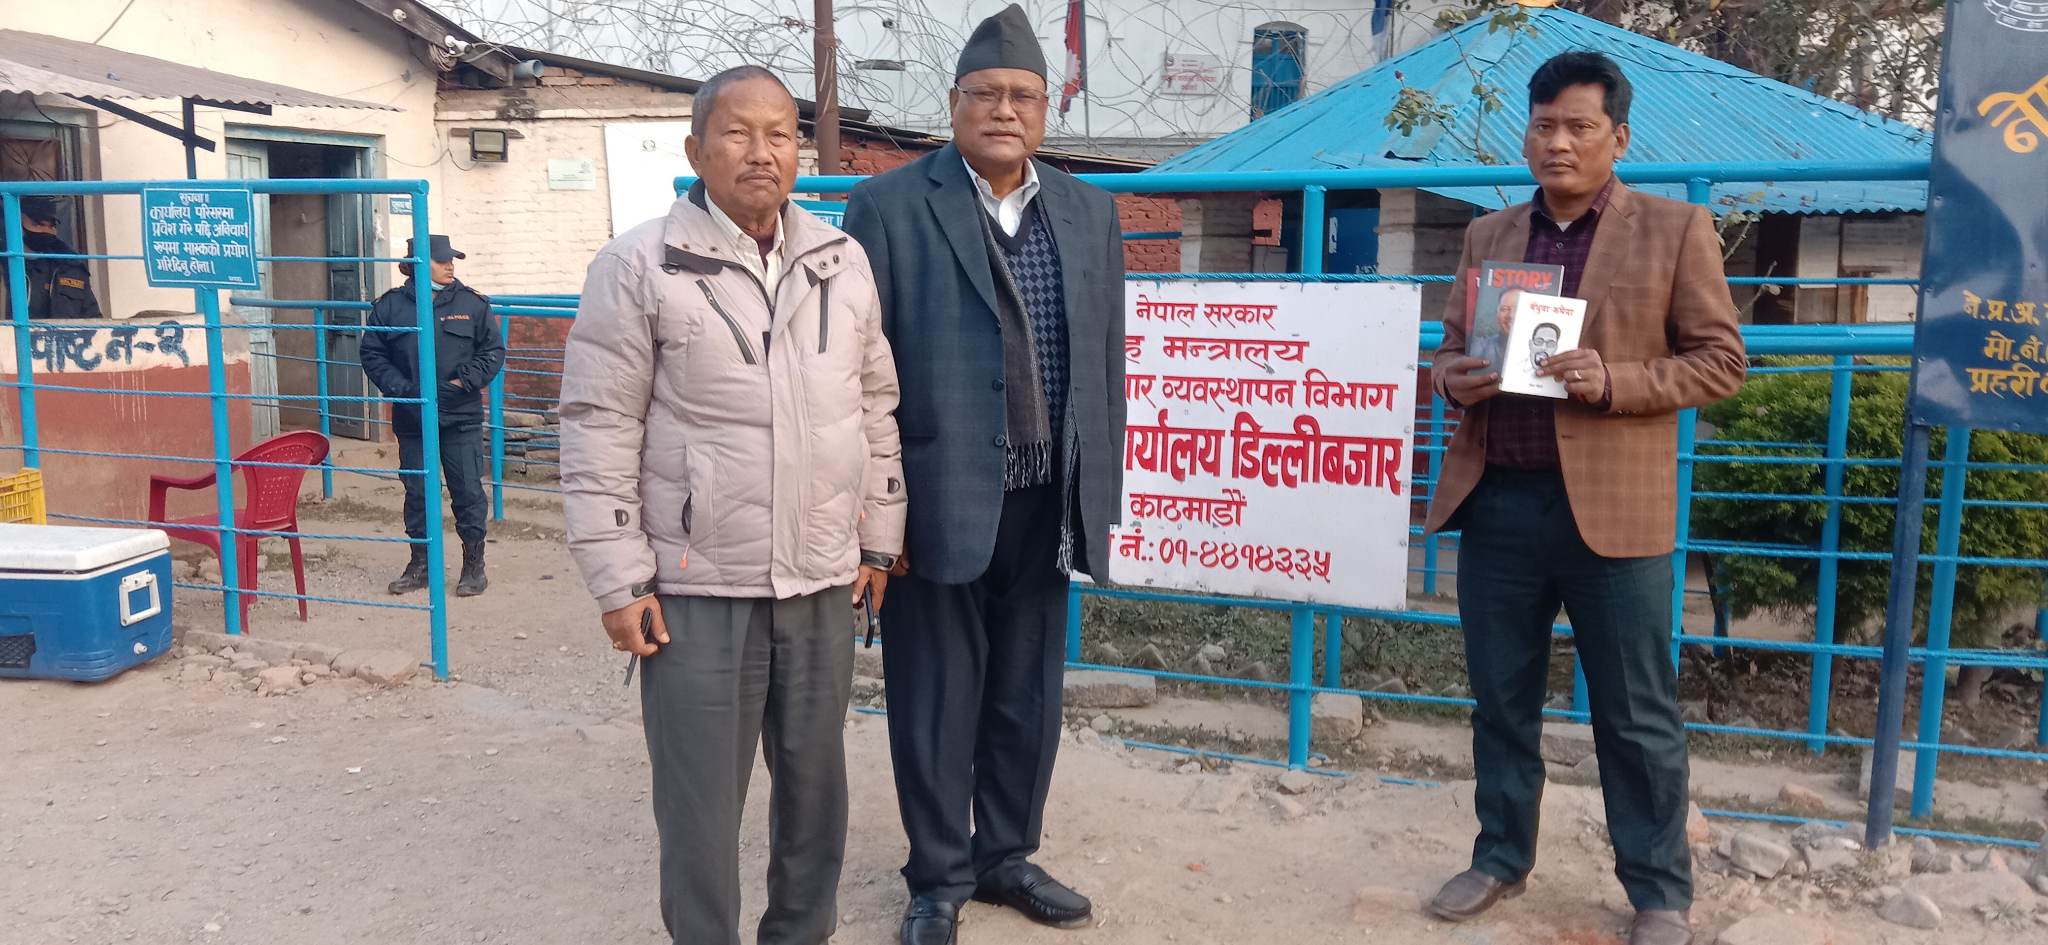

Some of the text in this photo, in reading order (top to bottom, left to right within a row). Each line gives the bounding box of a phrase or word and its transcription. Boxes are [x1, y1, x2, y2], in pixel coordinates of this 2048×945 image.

[150, 202, 234, 220] कार्यालय परिसरमा
[152, 220, 177, 236] प्रवेश
[222, 241, 249, 258] प्रयोग
[1493, 268, 1553, 290] STORY
[1136, 294, 1278, 331] नेपाल सरकार
[1163, 336, 1310, 370] मन्त्रालय
[1162, 375, 1297, 412] व्यवस्थापन
[1303, 368, 1399, 412] विभाग
[1965, 362, 2040, 399] प्रहरी
[1231, 411, 1404, 496] डिल्लीबजार
